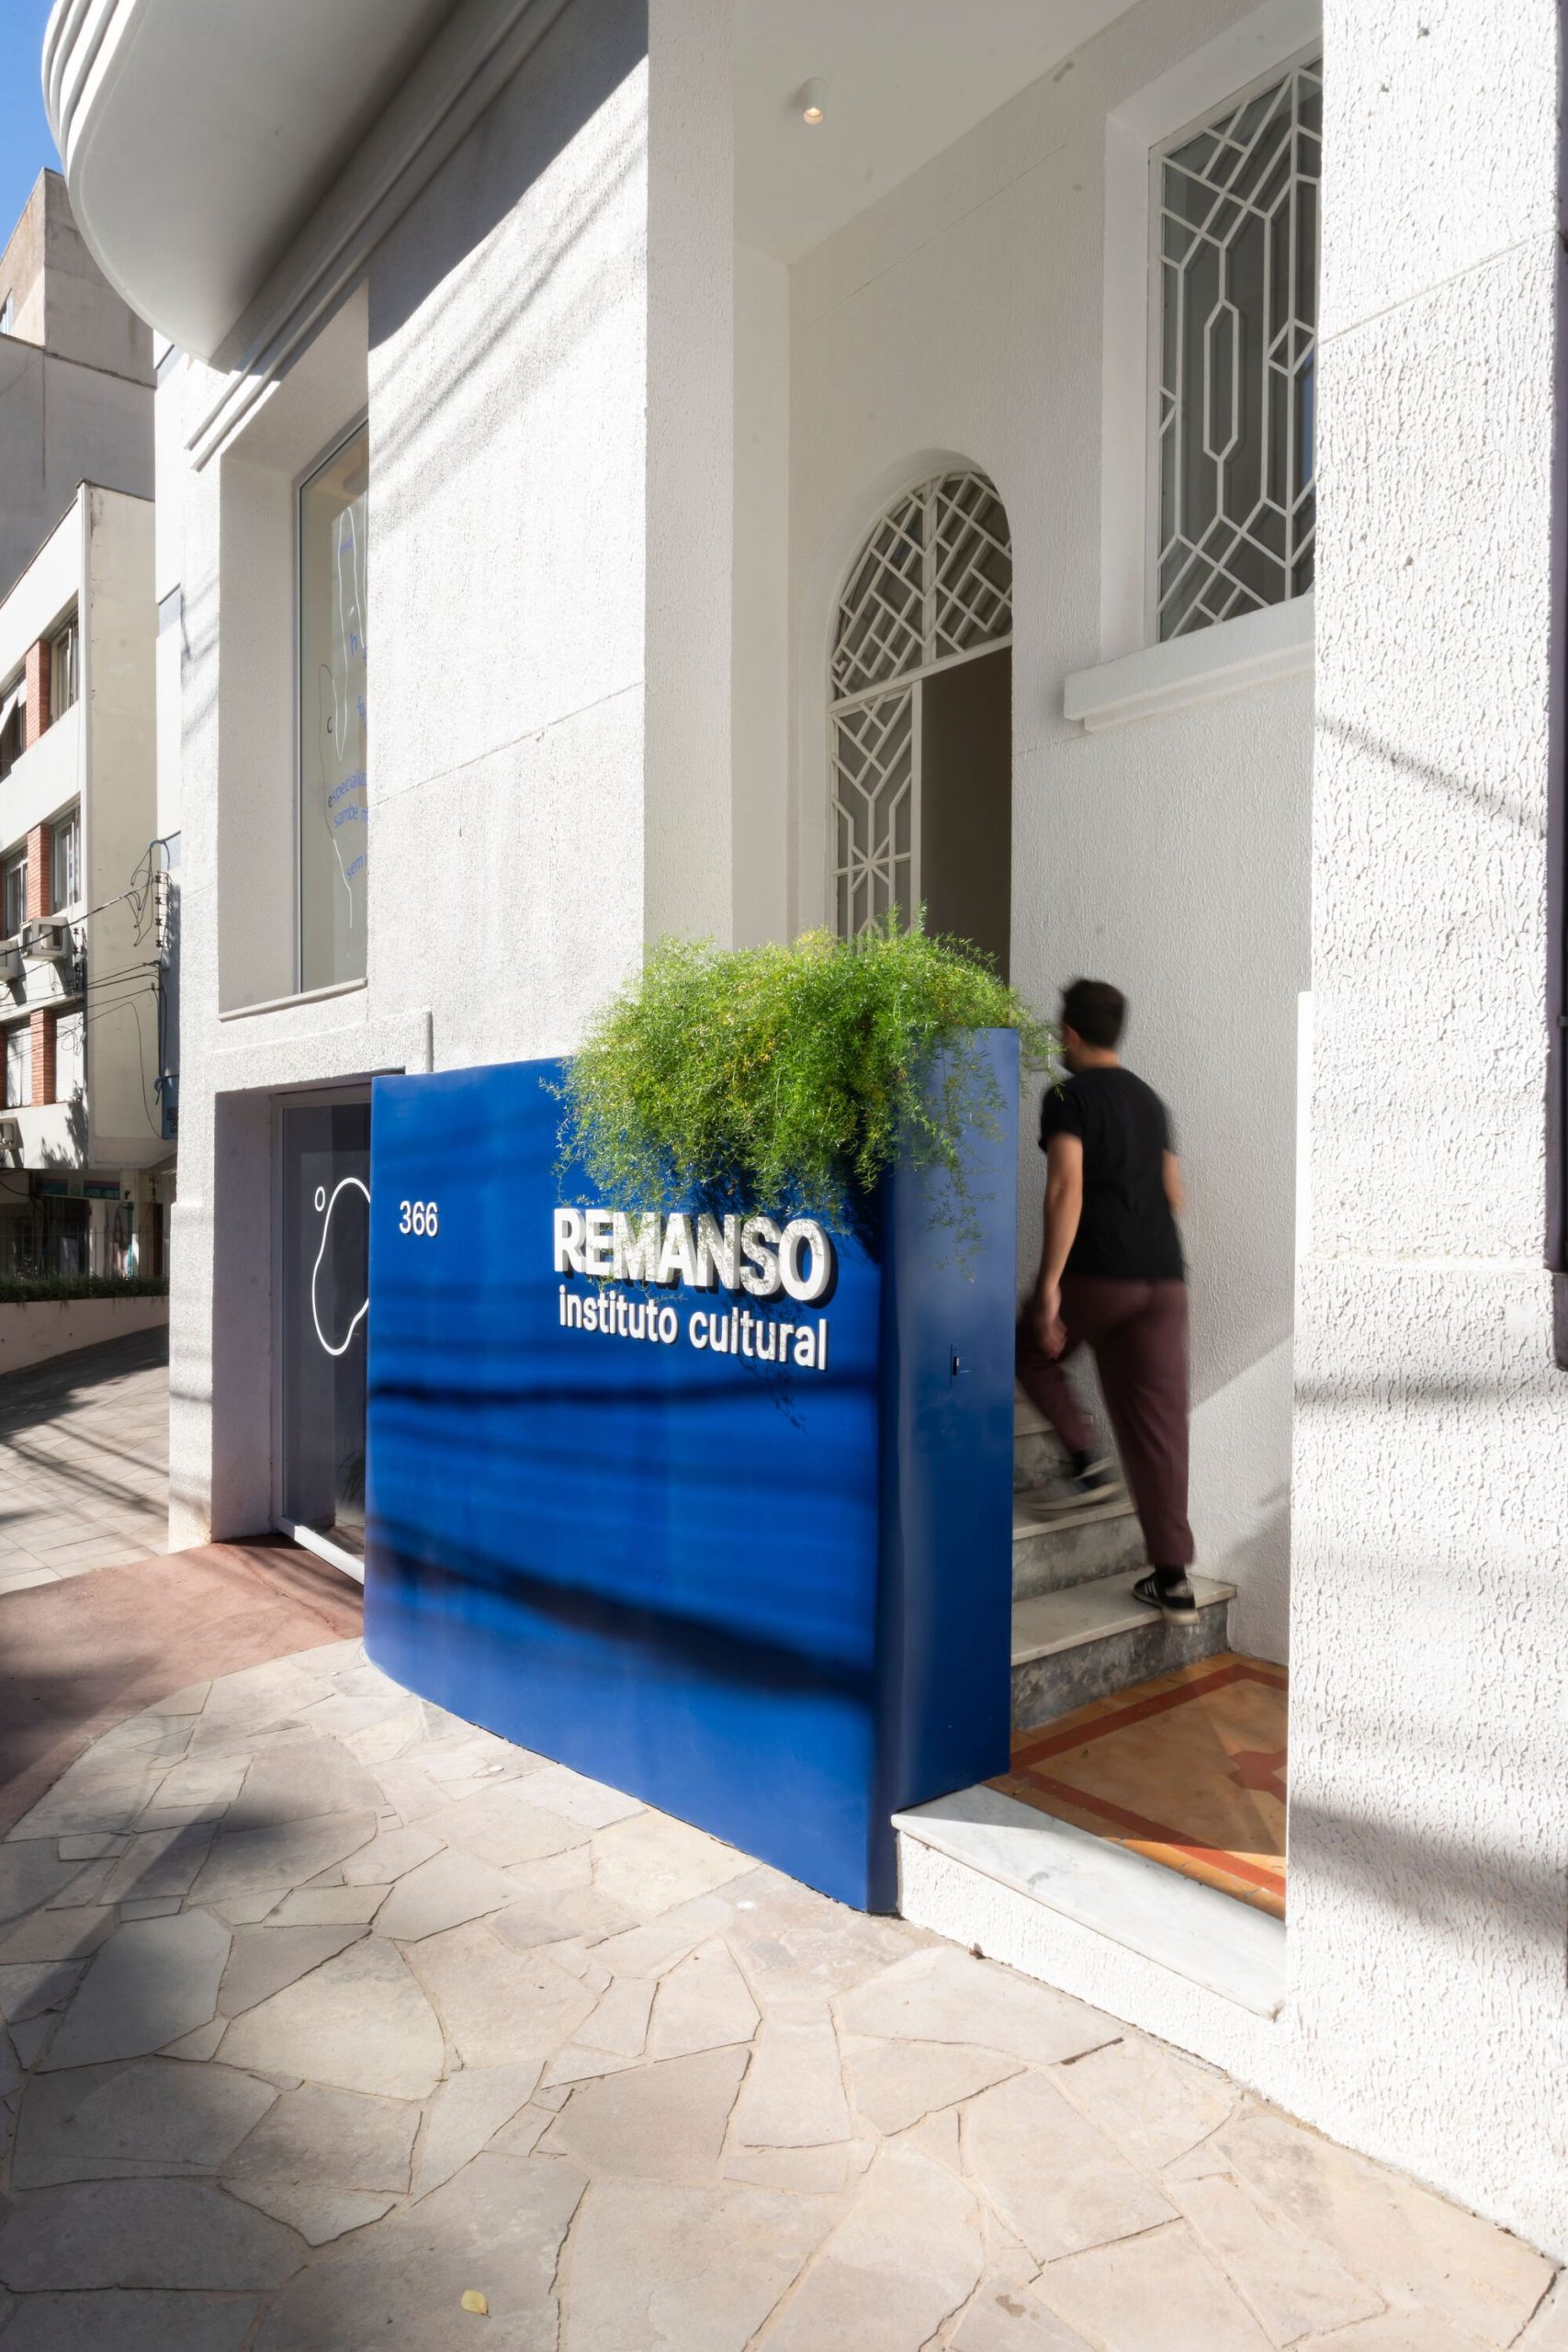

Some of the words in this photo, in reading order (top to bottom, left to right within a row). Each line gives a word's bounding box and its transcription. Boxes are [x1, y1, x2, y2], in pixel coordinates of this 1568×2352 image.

[399, 1200, 439, 1238] 366
[554, 1207, 833, 1301] REMANSO
[559, 1284, 679, 1344] instituto
[689, 1306, 828, 1371] cultural
